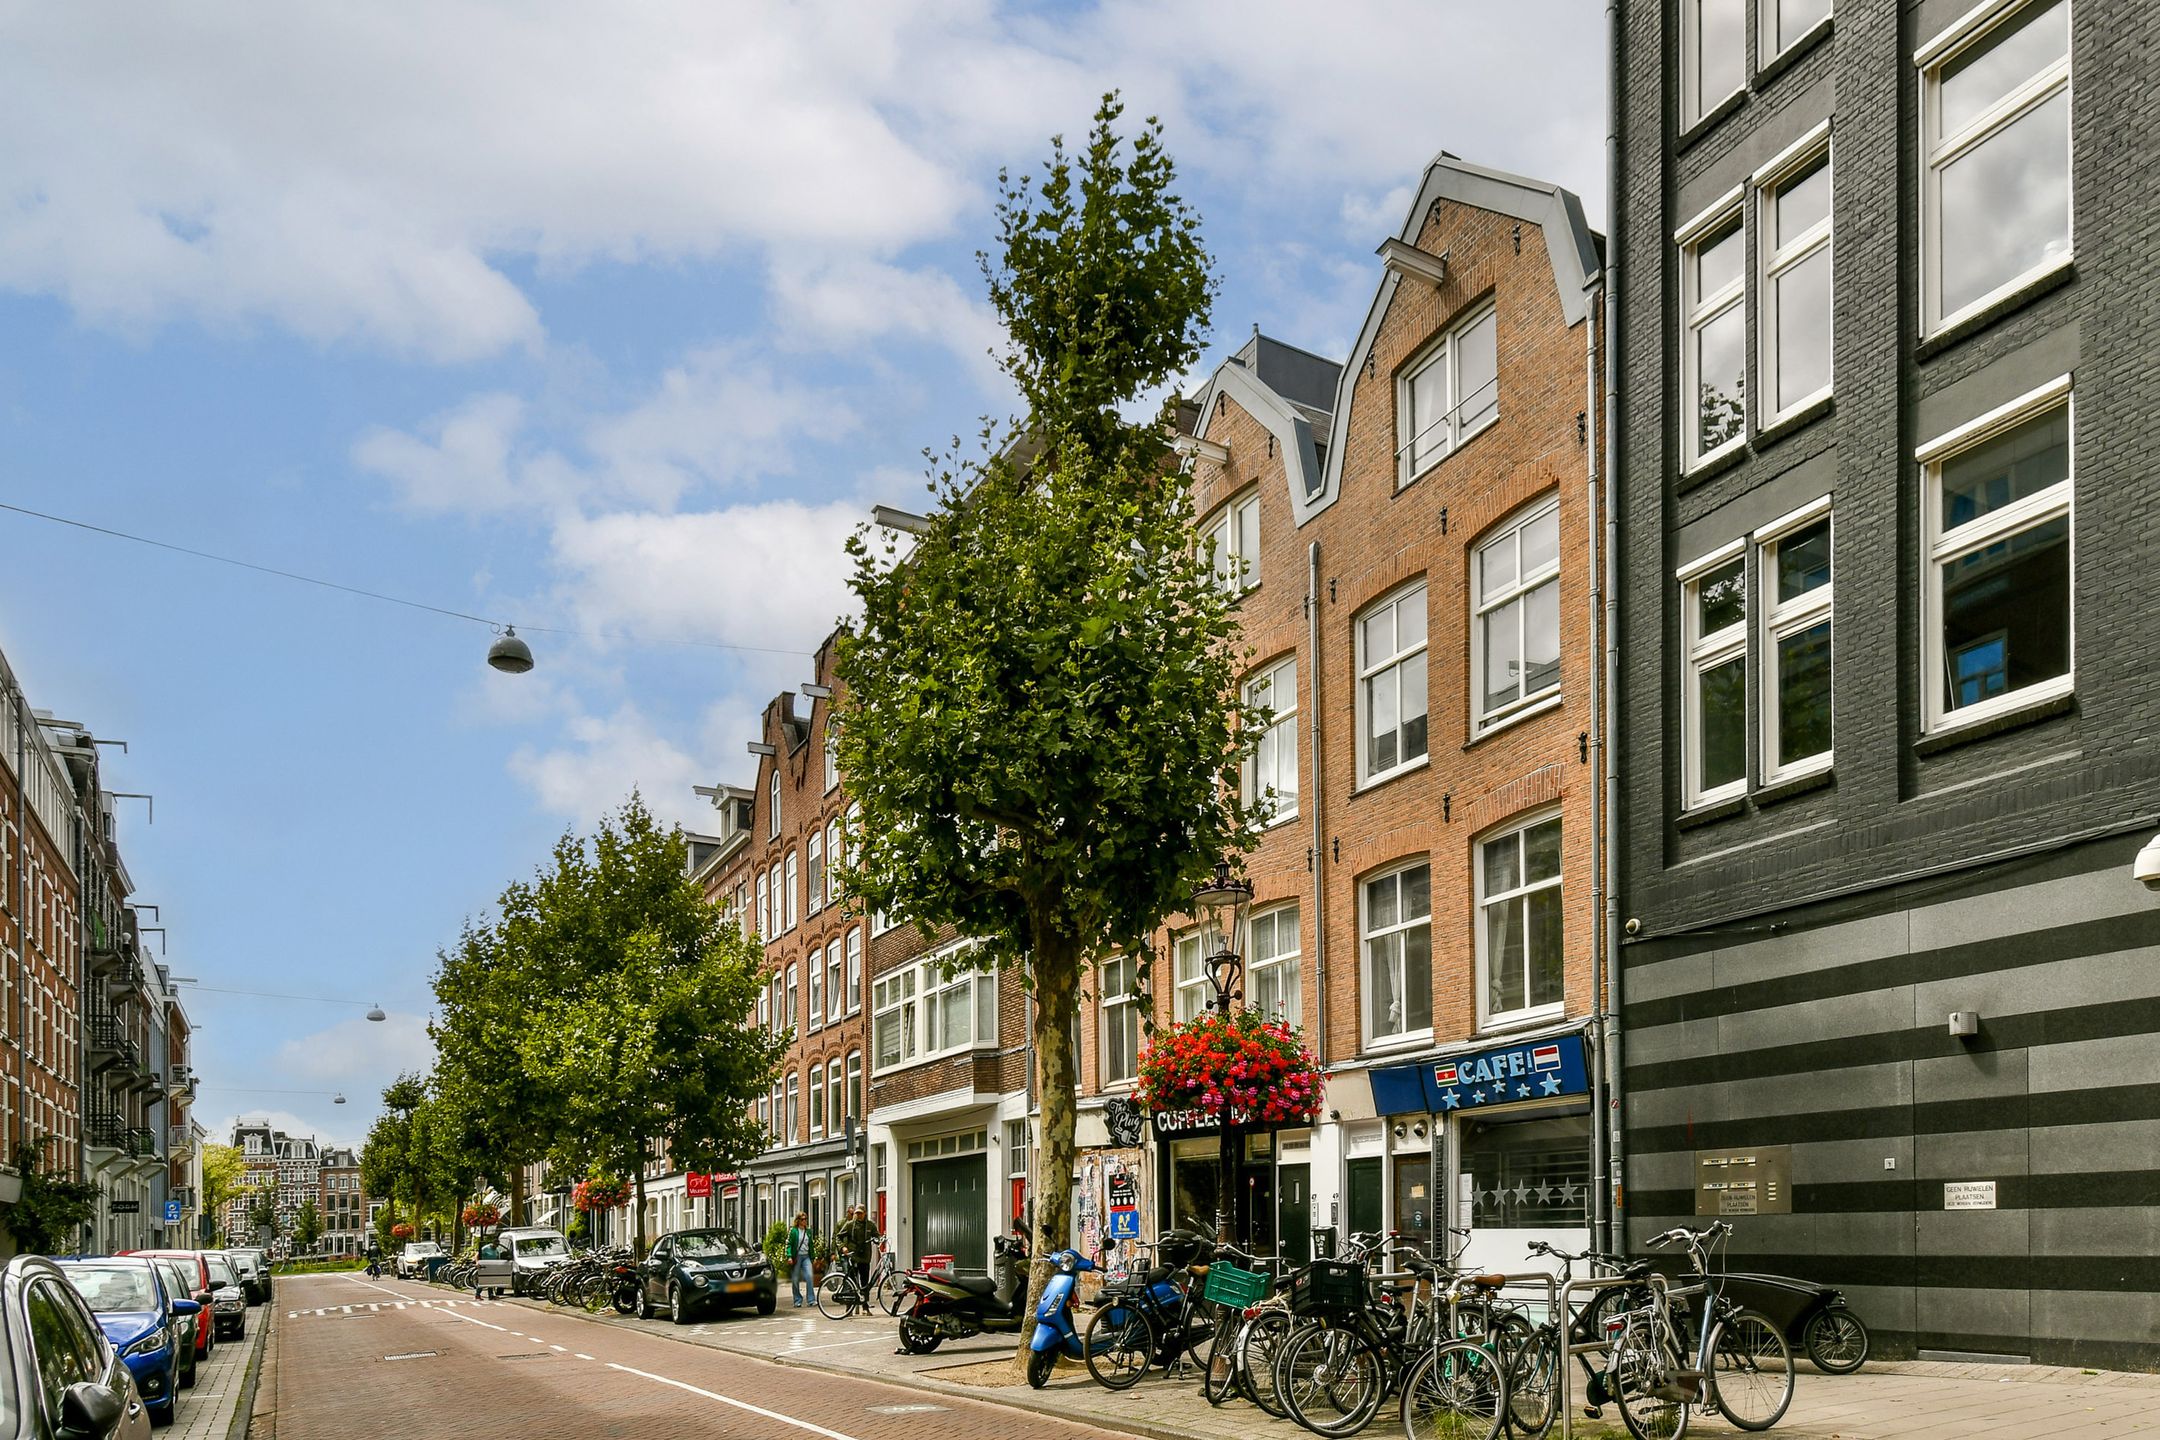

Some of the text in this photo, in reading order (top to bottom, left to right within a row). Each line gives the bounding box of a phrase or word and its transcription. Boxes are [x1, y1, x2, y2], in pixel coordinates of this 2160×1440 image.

[1110, 1101, 1126, 1114] The
[1115, 1111, 1140, 1132] Plug
[1954, 1193, 1984, 1201] PLAATSEN
